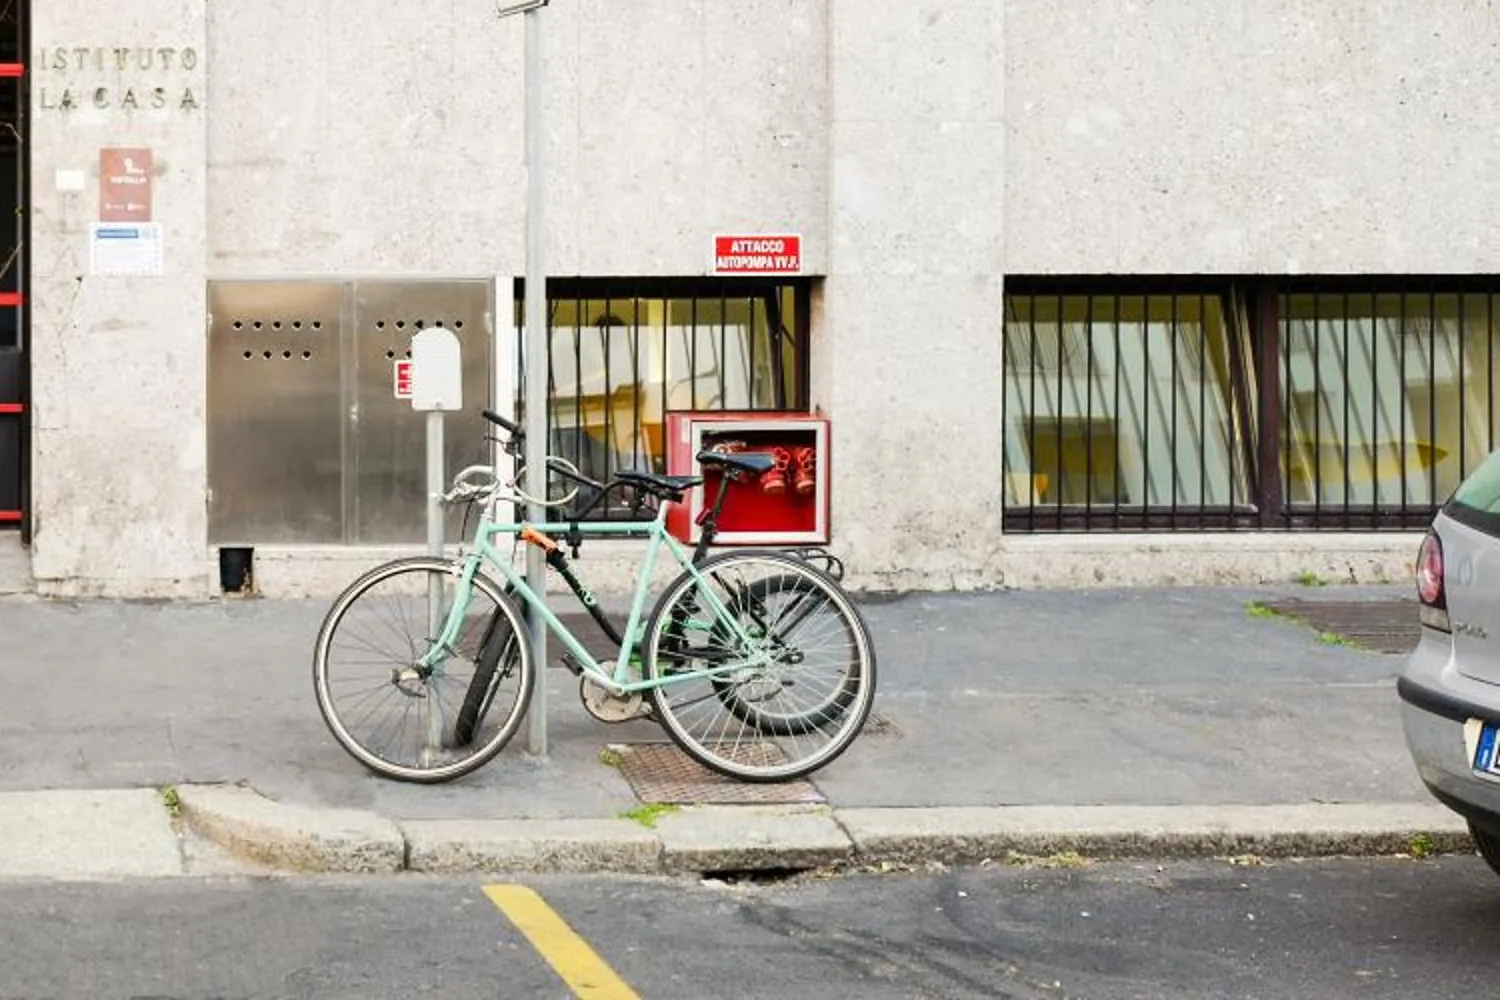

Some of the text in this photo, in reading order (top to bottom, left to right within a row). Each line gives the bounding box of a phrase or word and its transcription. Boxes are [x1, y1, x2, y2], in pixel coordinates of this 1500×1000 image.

[38, 47, 198, 71] ISTITUTO
[38, 87, 199, 110] LA CASA
[731, 239, 785, 253] ATTACCO
